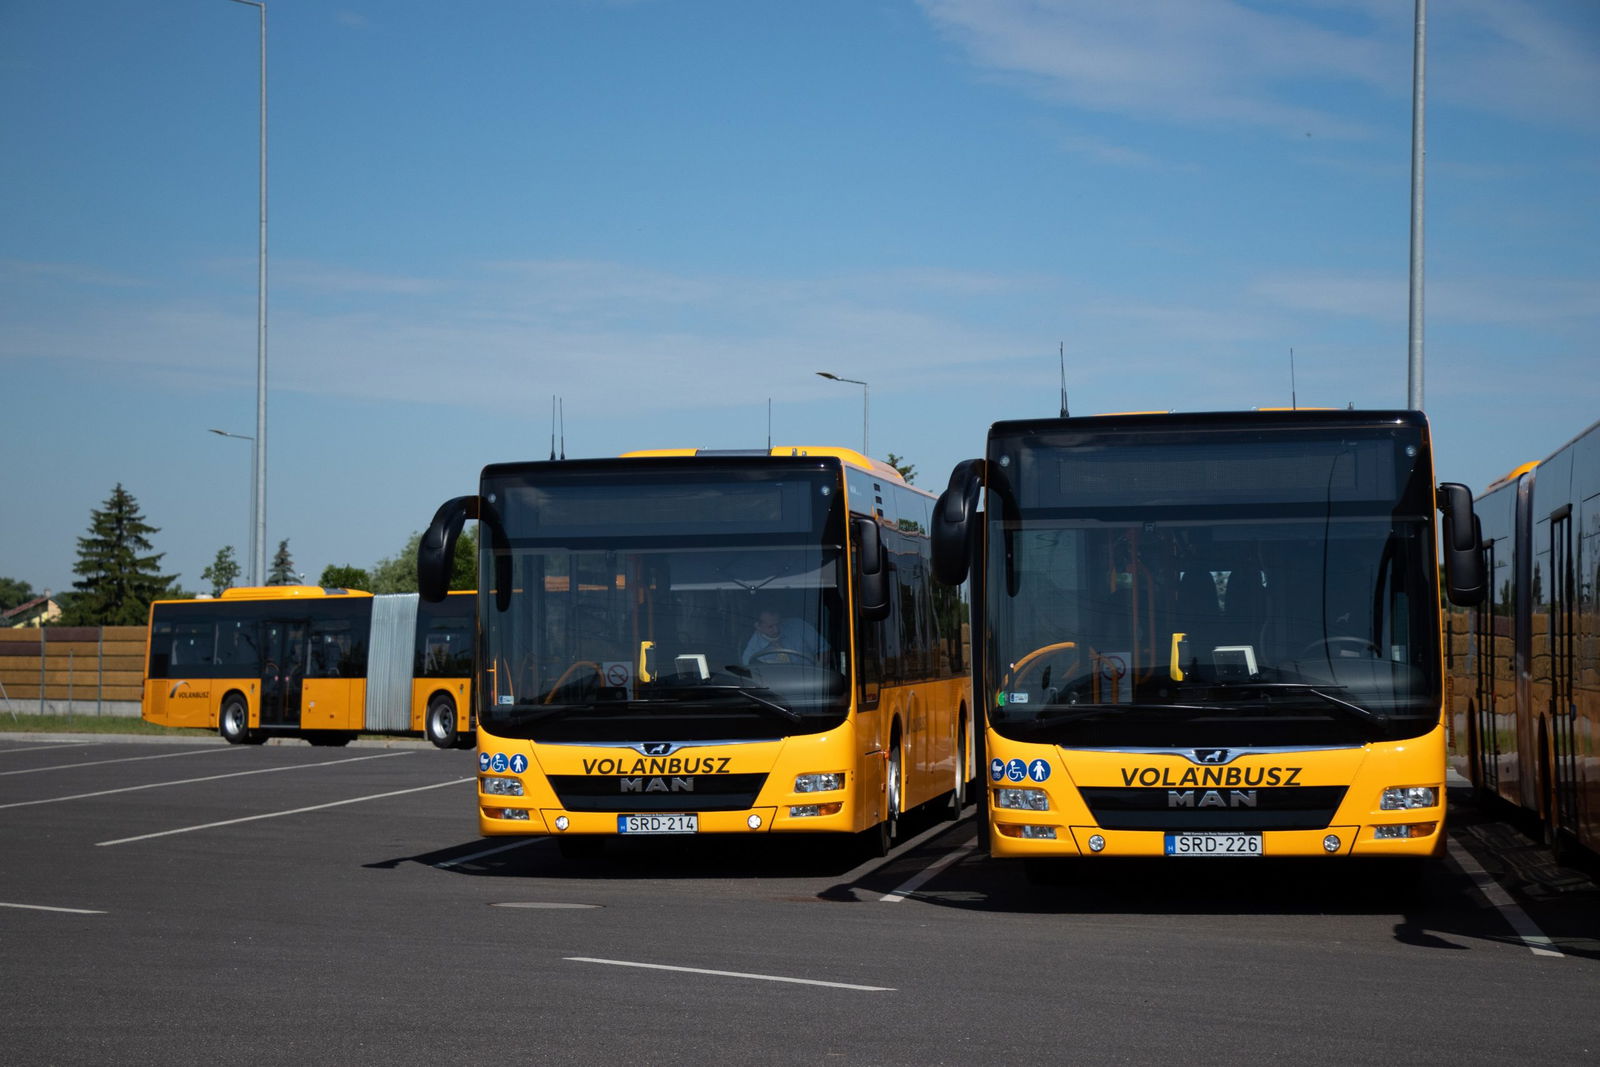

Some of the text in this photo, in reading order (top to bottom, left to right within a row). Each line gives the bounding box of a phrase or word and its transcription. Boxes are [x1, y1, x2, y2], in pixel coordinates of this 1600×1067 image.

[582, 757, 732, 775] VOLÁNBUSZ
[620, 777, 694, 792] MAN
[1121, 767, 1303, 786] VOLÁNBUSZ
[1168, 790, 1257, 807] MAN
[629, 817, 694, 831] SRD-214
[1179, 837, 1258, 852] SRD-226
